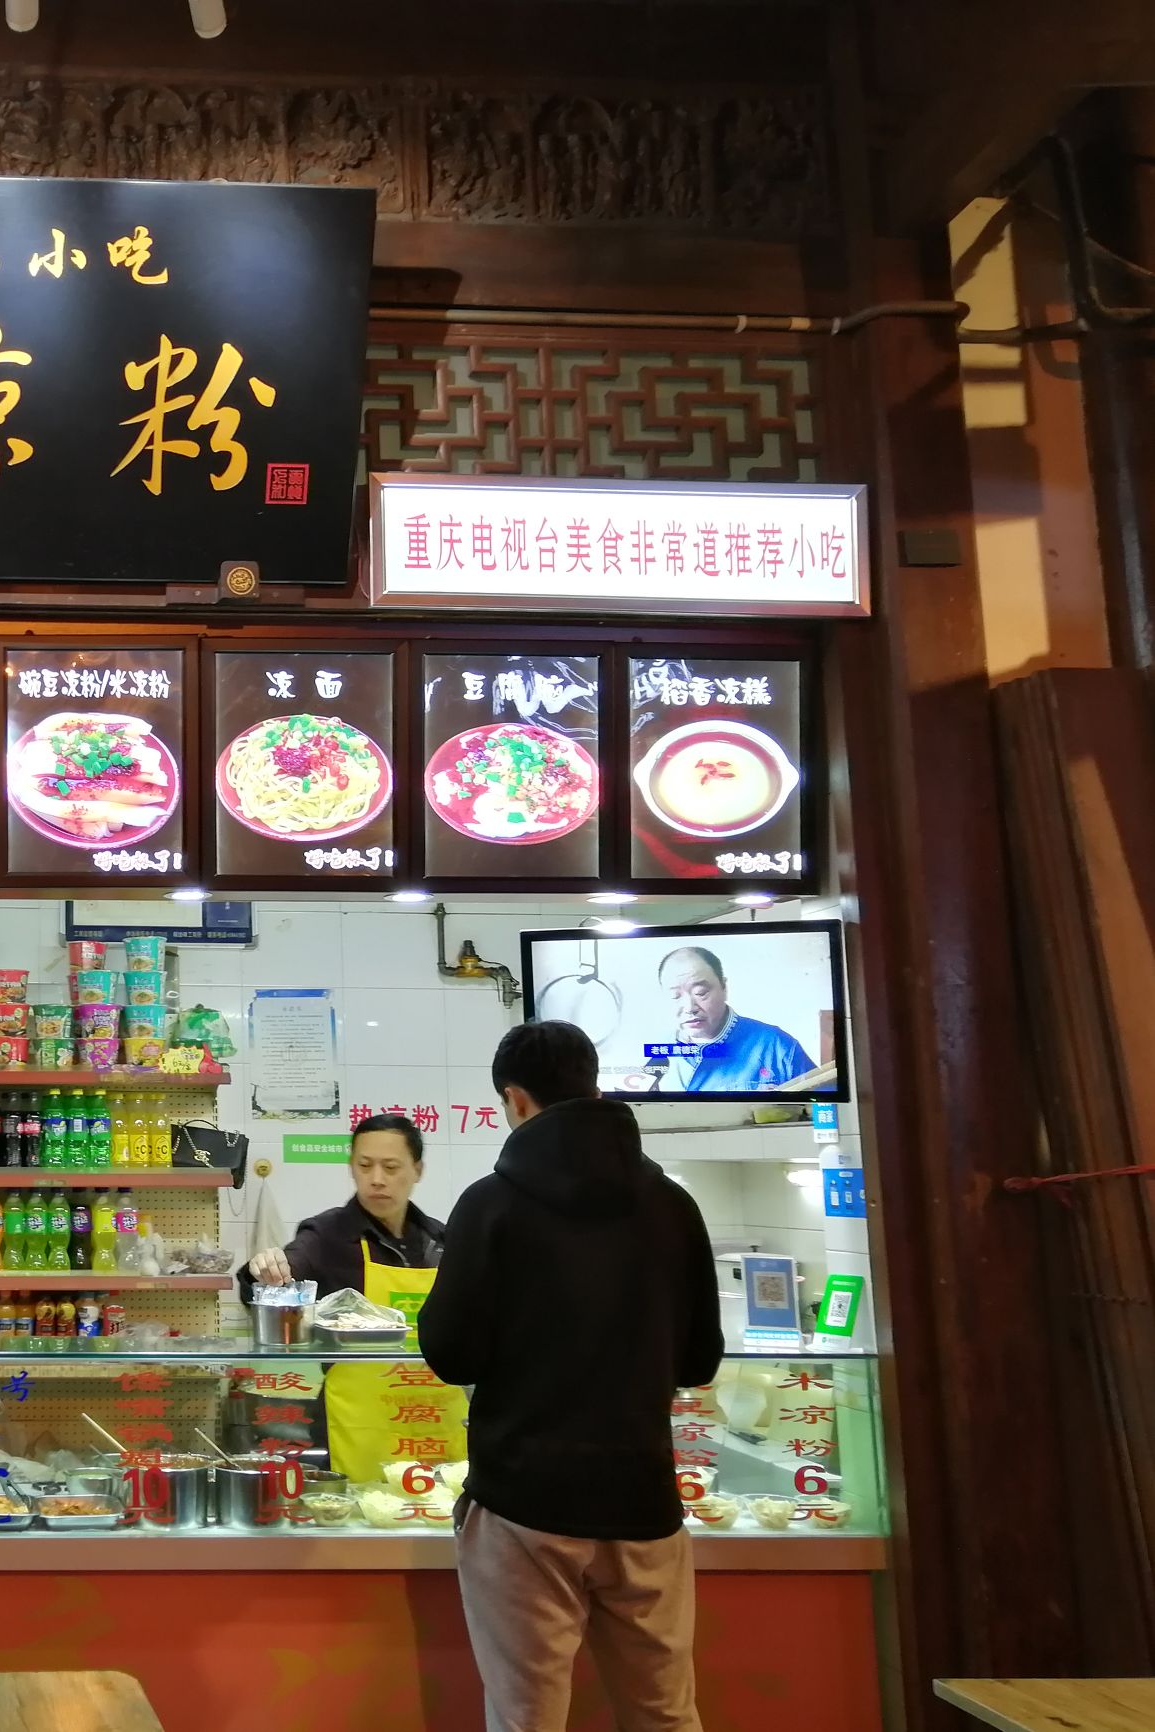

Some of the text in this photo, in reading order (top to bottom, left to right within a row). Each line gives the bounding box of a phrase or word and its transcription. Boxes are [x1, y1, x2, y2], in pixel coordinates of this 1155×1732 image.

[404, 513, 847, 578] 重庆电视台美食非常道推荐小吃
[265, 670, 342, 699] 凉面
[451, 1105, 500, 1134] 7元
